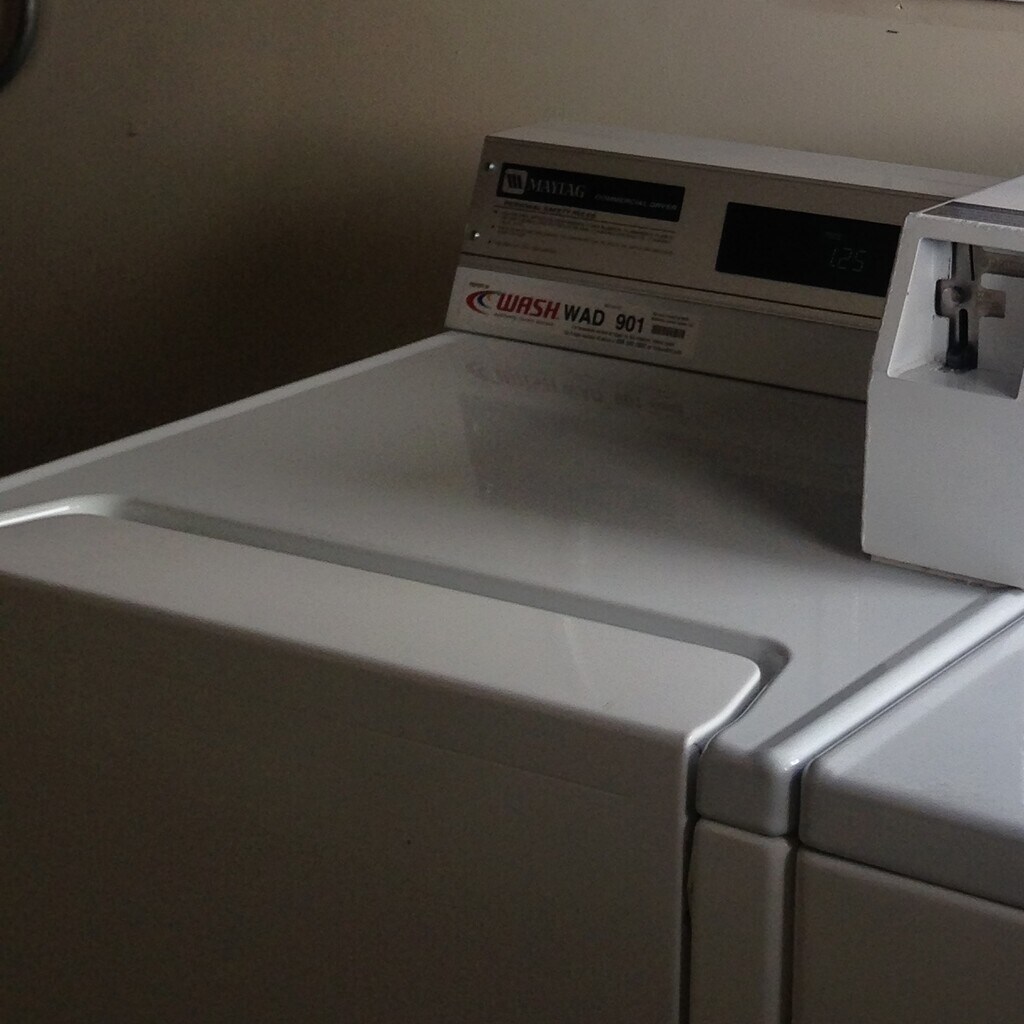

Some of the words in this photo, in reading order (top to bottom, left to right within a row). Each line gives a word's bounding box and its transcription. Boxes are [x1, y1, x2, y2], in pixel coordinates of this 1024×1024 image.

[528, 178, 585, 198] MAYTAG
[496, 293, 561, 319] WASH
[564, 304, 605, 326] WAD
[616, 314, 645, 333] 901
